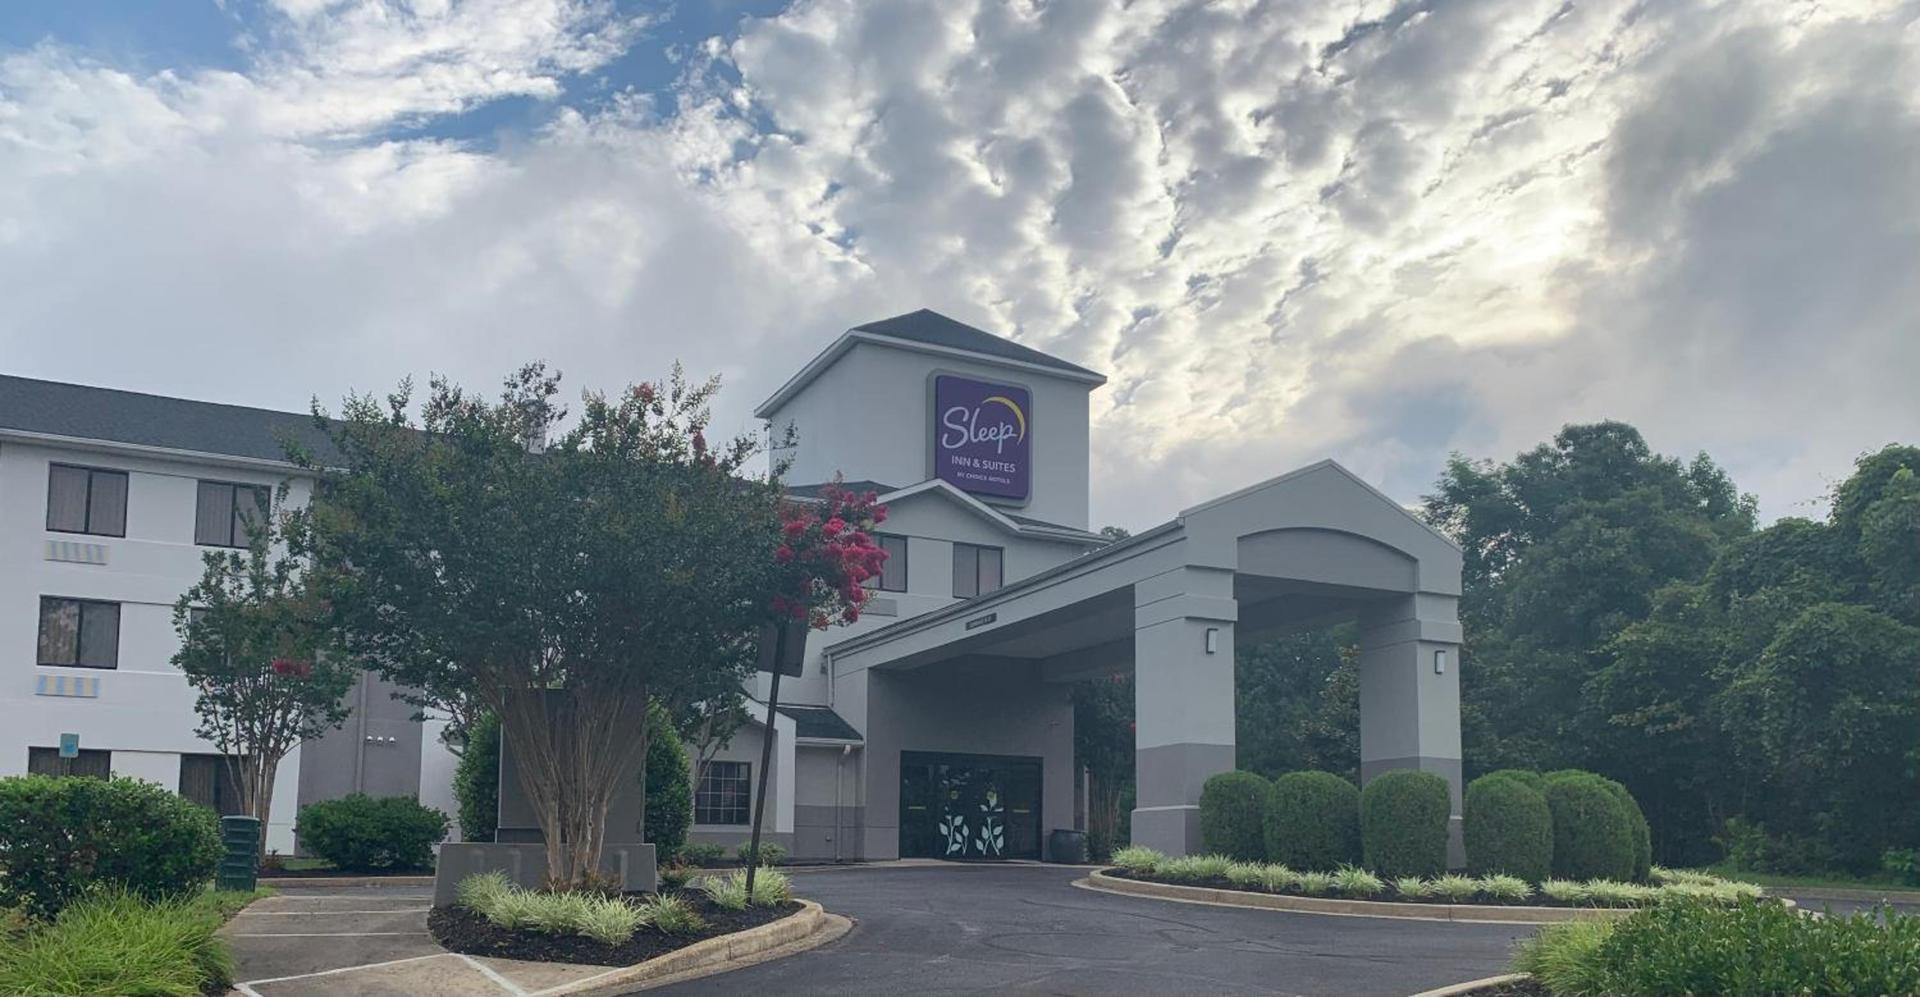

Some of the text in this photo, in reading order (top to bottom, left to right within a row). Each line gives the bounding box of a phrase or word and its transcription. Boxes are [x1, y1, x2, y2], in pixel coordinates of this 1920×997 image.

[942, 406, 1017, 454] Sleep
[951, 455, 1016, 473] INN & SUITES
